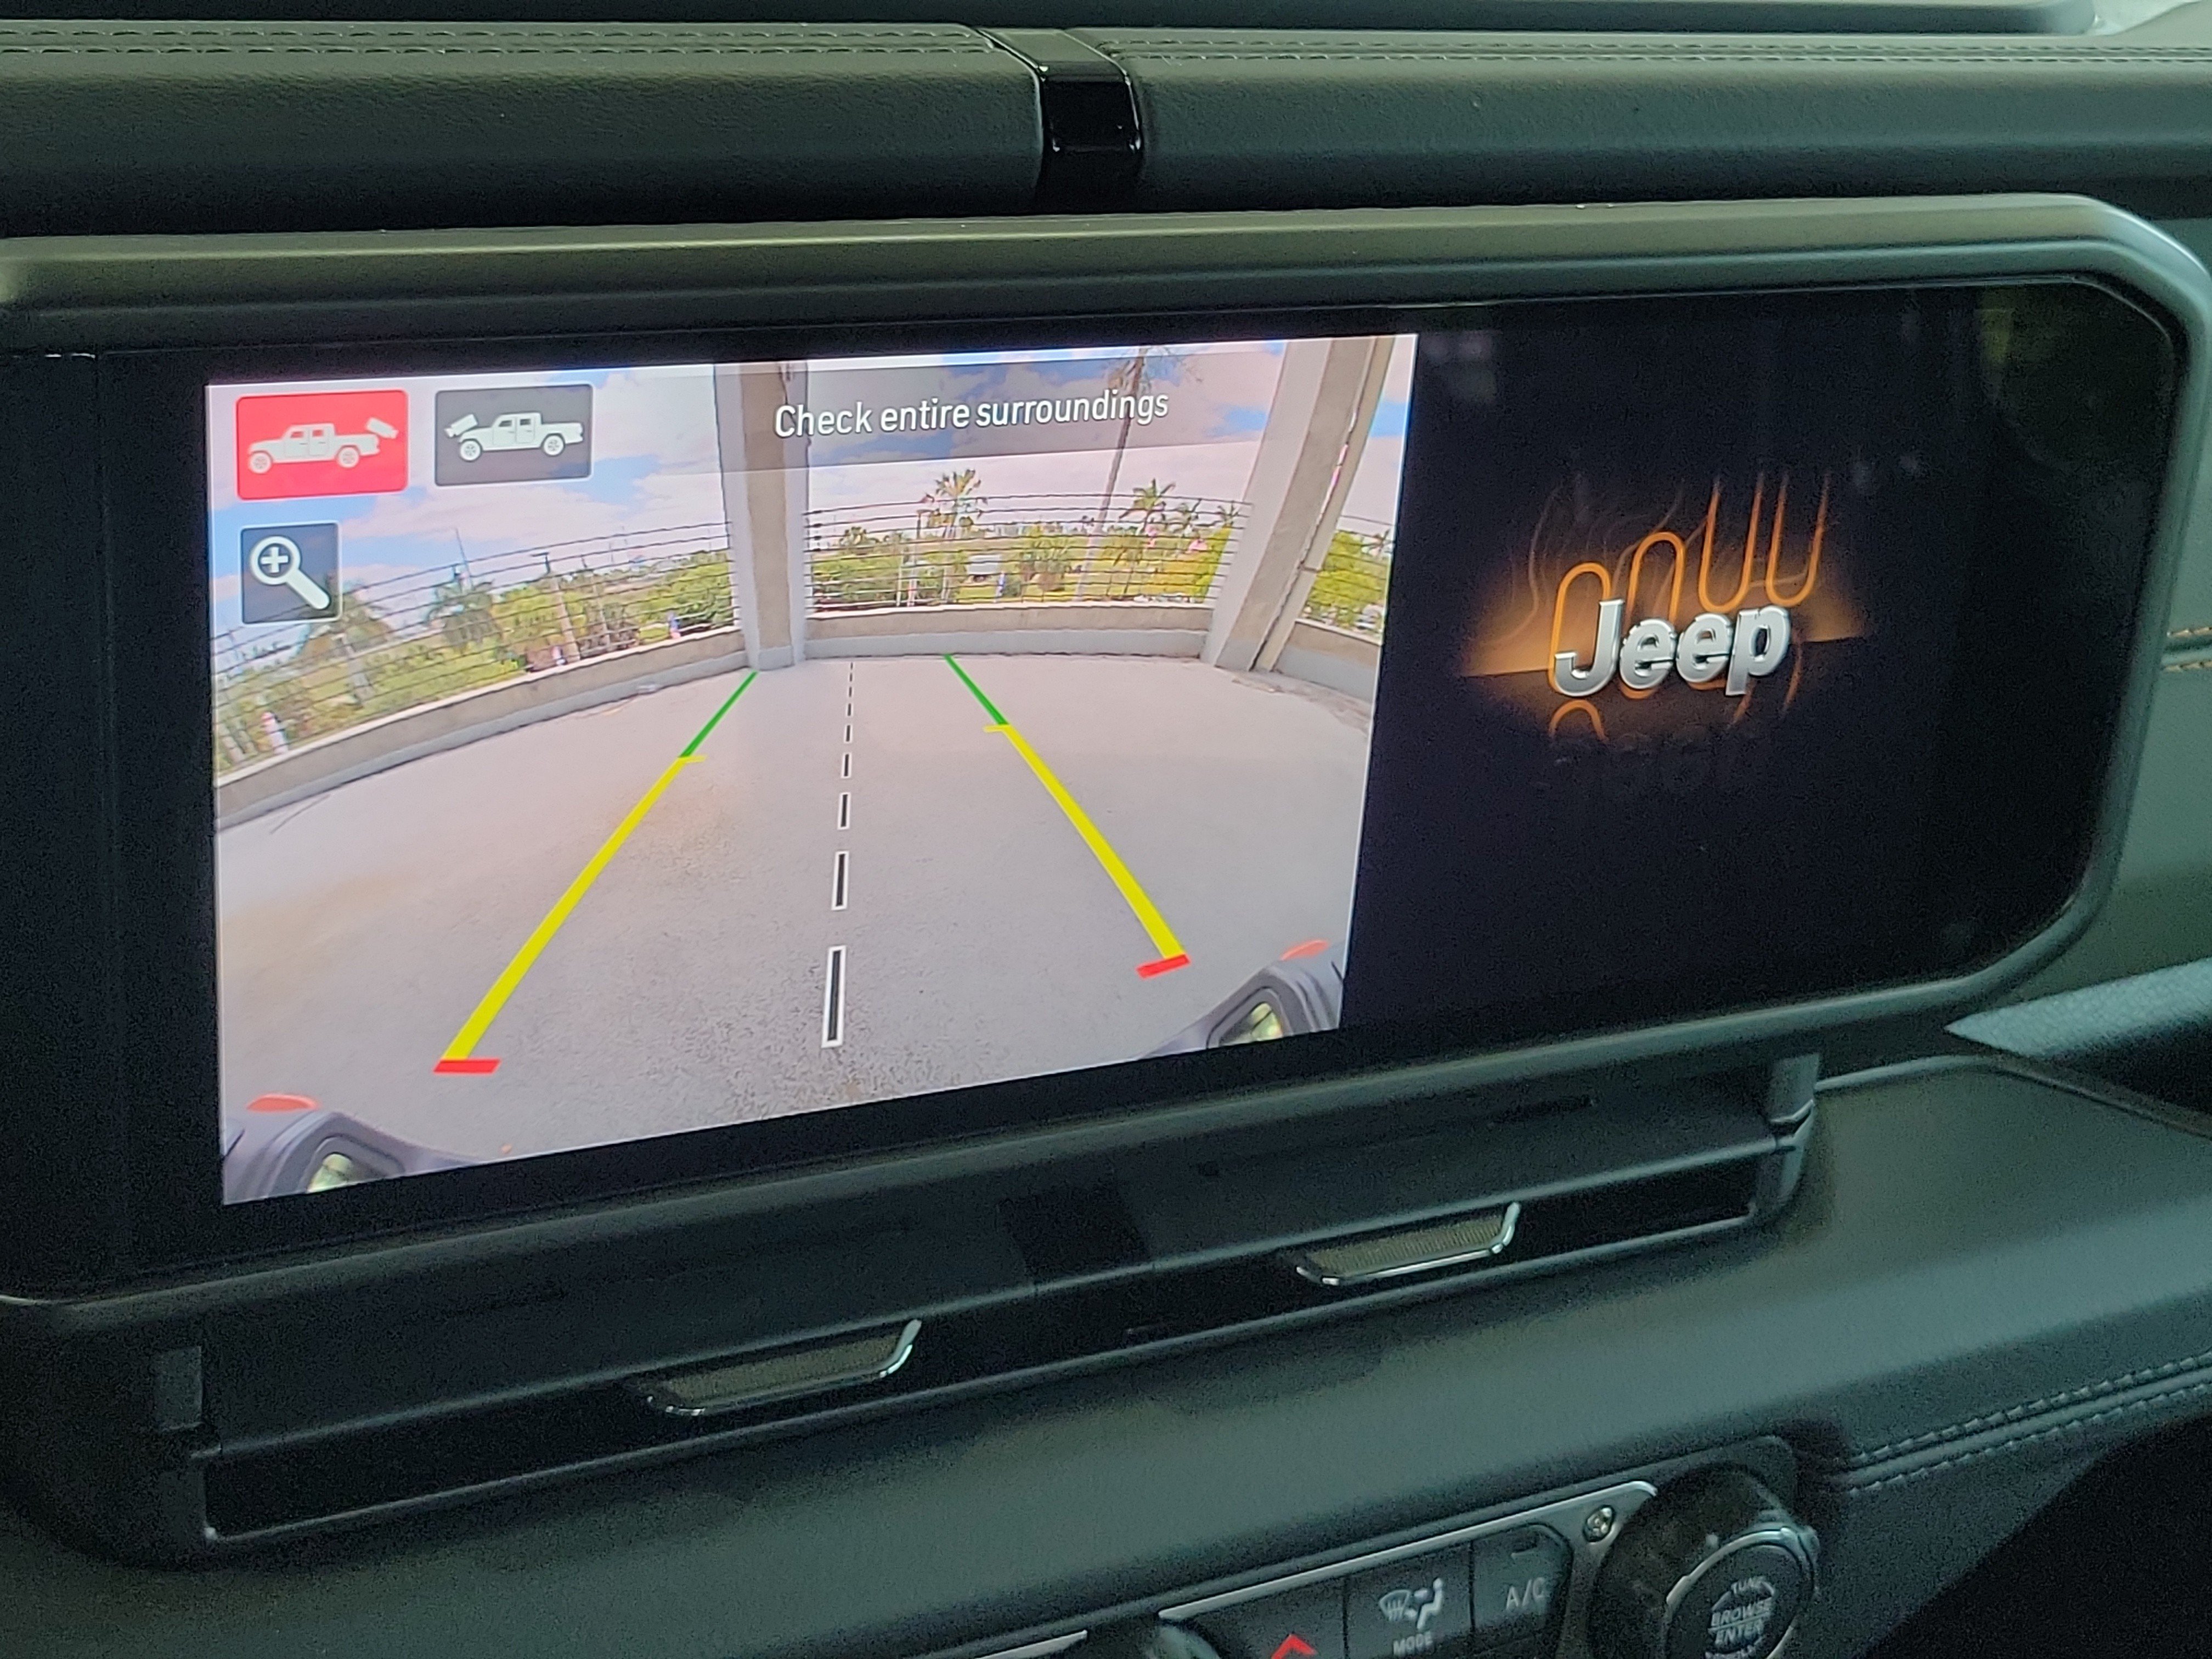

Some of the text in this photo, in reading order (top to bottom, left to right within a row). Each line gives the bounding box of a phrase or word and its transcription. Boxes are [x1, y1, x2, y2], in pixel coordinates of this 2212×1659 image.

[775, 389, 1169, 437] Check entire surroundings
[1554, 597, 1791, 697] Jeep
[1505, 1577, 1549, 1611] A/C
[1711, 1599, 1773, 1627] BROWSE
[1393, 1632, 1434, 1657] MODE
[1714, 1618, 1765, 1646] ENTER
